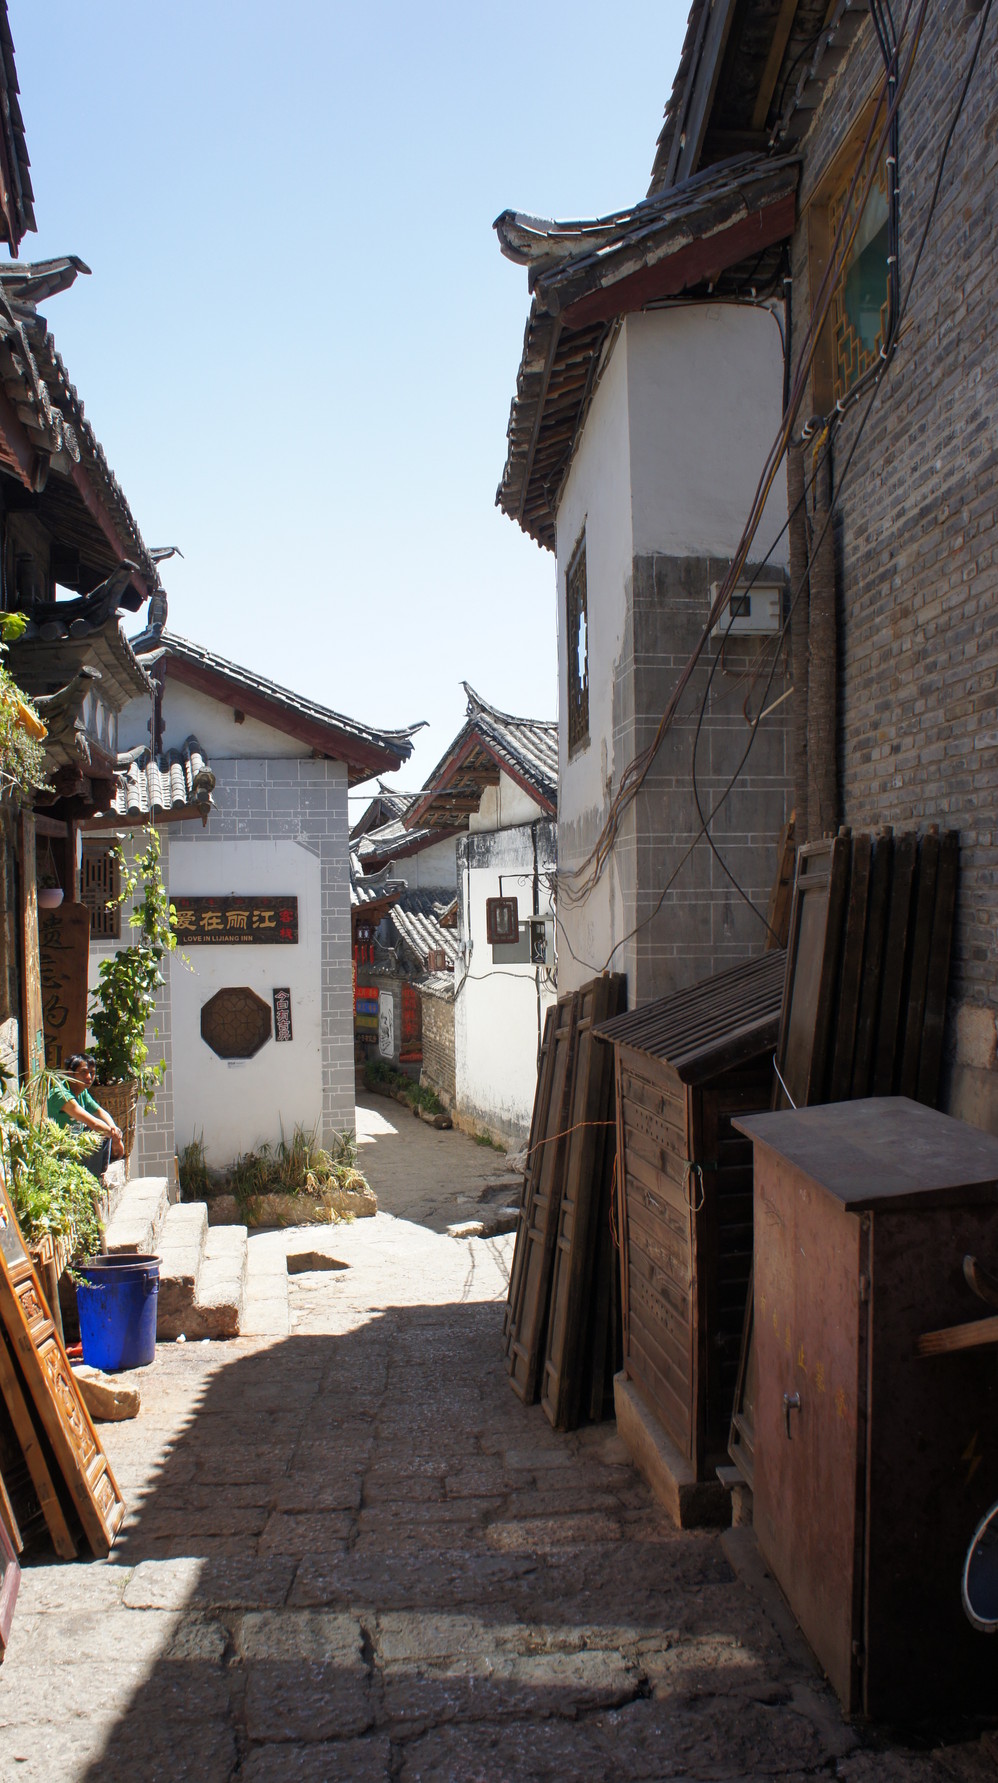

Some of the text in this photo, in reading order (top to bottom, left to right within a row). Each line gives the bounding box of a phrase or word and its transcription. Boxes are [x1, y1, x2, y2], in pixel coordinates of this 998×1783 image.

[173, 911, 277, 931] 爱在丽江
[279, 909, 293, 940] 客栈
